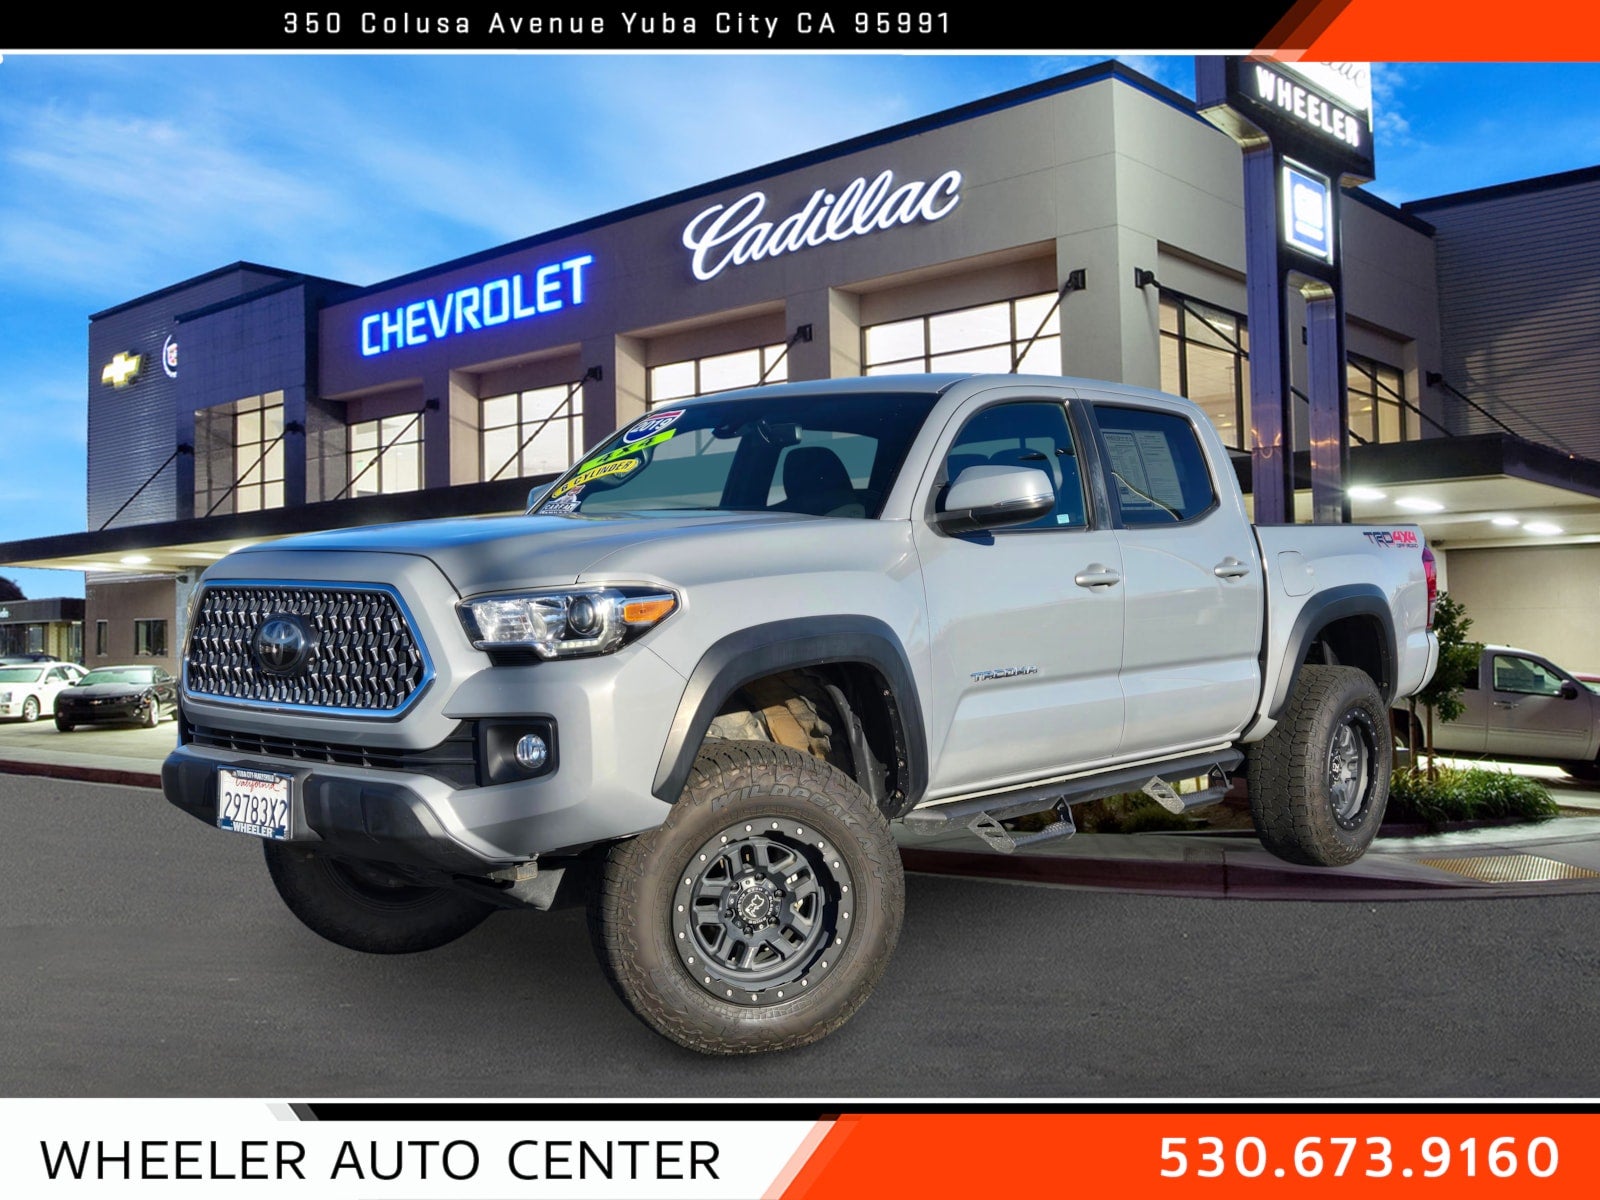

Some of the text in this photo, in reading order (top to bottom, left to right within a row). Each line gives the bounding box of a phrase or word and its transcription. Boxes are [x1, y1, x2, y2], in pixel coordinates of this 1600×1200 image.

[1255, 65, 1360, 148] WHEELER
[682, 169, 962, 281] Cadillac
[361, 255, 593, 356] CHEVROLET
[630, 417, 672, 432] 2019
[574, 461, 633, 485] CYLINDER
[1362, 531, 1395, 549] TRD
[970, 665, 1038, 682] TACOMA
[224, 792, 288, 828] 29783X2
[712, 784, 860, 827] WILDPEAK
[233, 821, 273, 838] WHEELER
